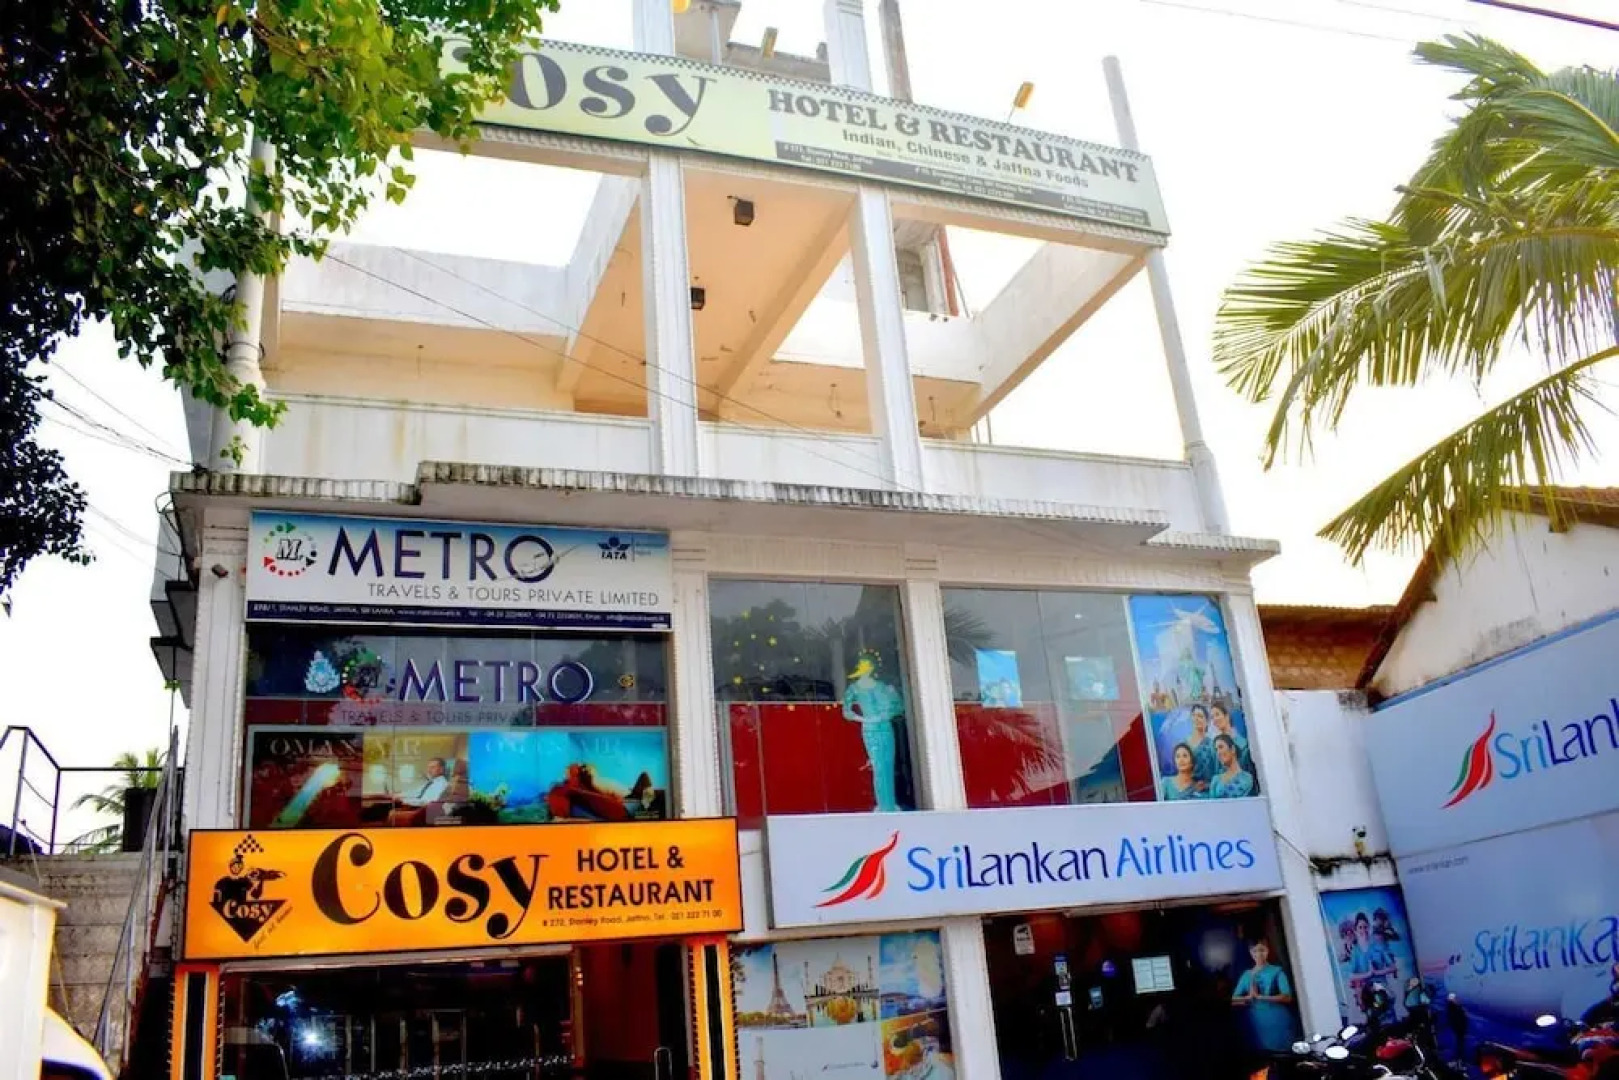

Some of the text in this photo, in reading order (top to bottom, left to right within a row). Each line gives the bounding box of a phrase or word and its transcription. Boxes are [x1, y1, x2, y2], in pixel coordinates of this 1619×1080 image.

[767, 88, 889, 131] HOTEL
[894, 112, 922, 137] &
[929, 118, 1141, 184] RESTAURANT
[842, 127, 902, 153] Indian,
[906, 140, 971, 166] Chinese
[976, 154, 988, 169] &
[992, 157, 1042, 182] Jaffna
[1045, 168, 1090, 189] Foods
[328, 526, 556, 584] METRO
[600, 551, 628, 560] IATA
[367, 582, 660, 607] TRAVELS & TOURS PRIVATE LIMITED
[398, 658, 595, 705] METRO
[576, 846, 684, 873] HOTEL &
[906, 835, 1256, 893] SriLankan Airlines
[310, 831, 550, 940] Cosy
[548, 879, 715, 910] RESTAURANT
[222, 899, 274, 924] Cosy
